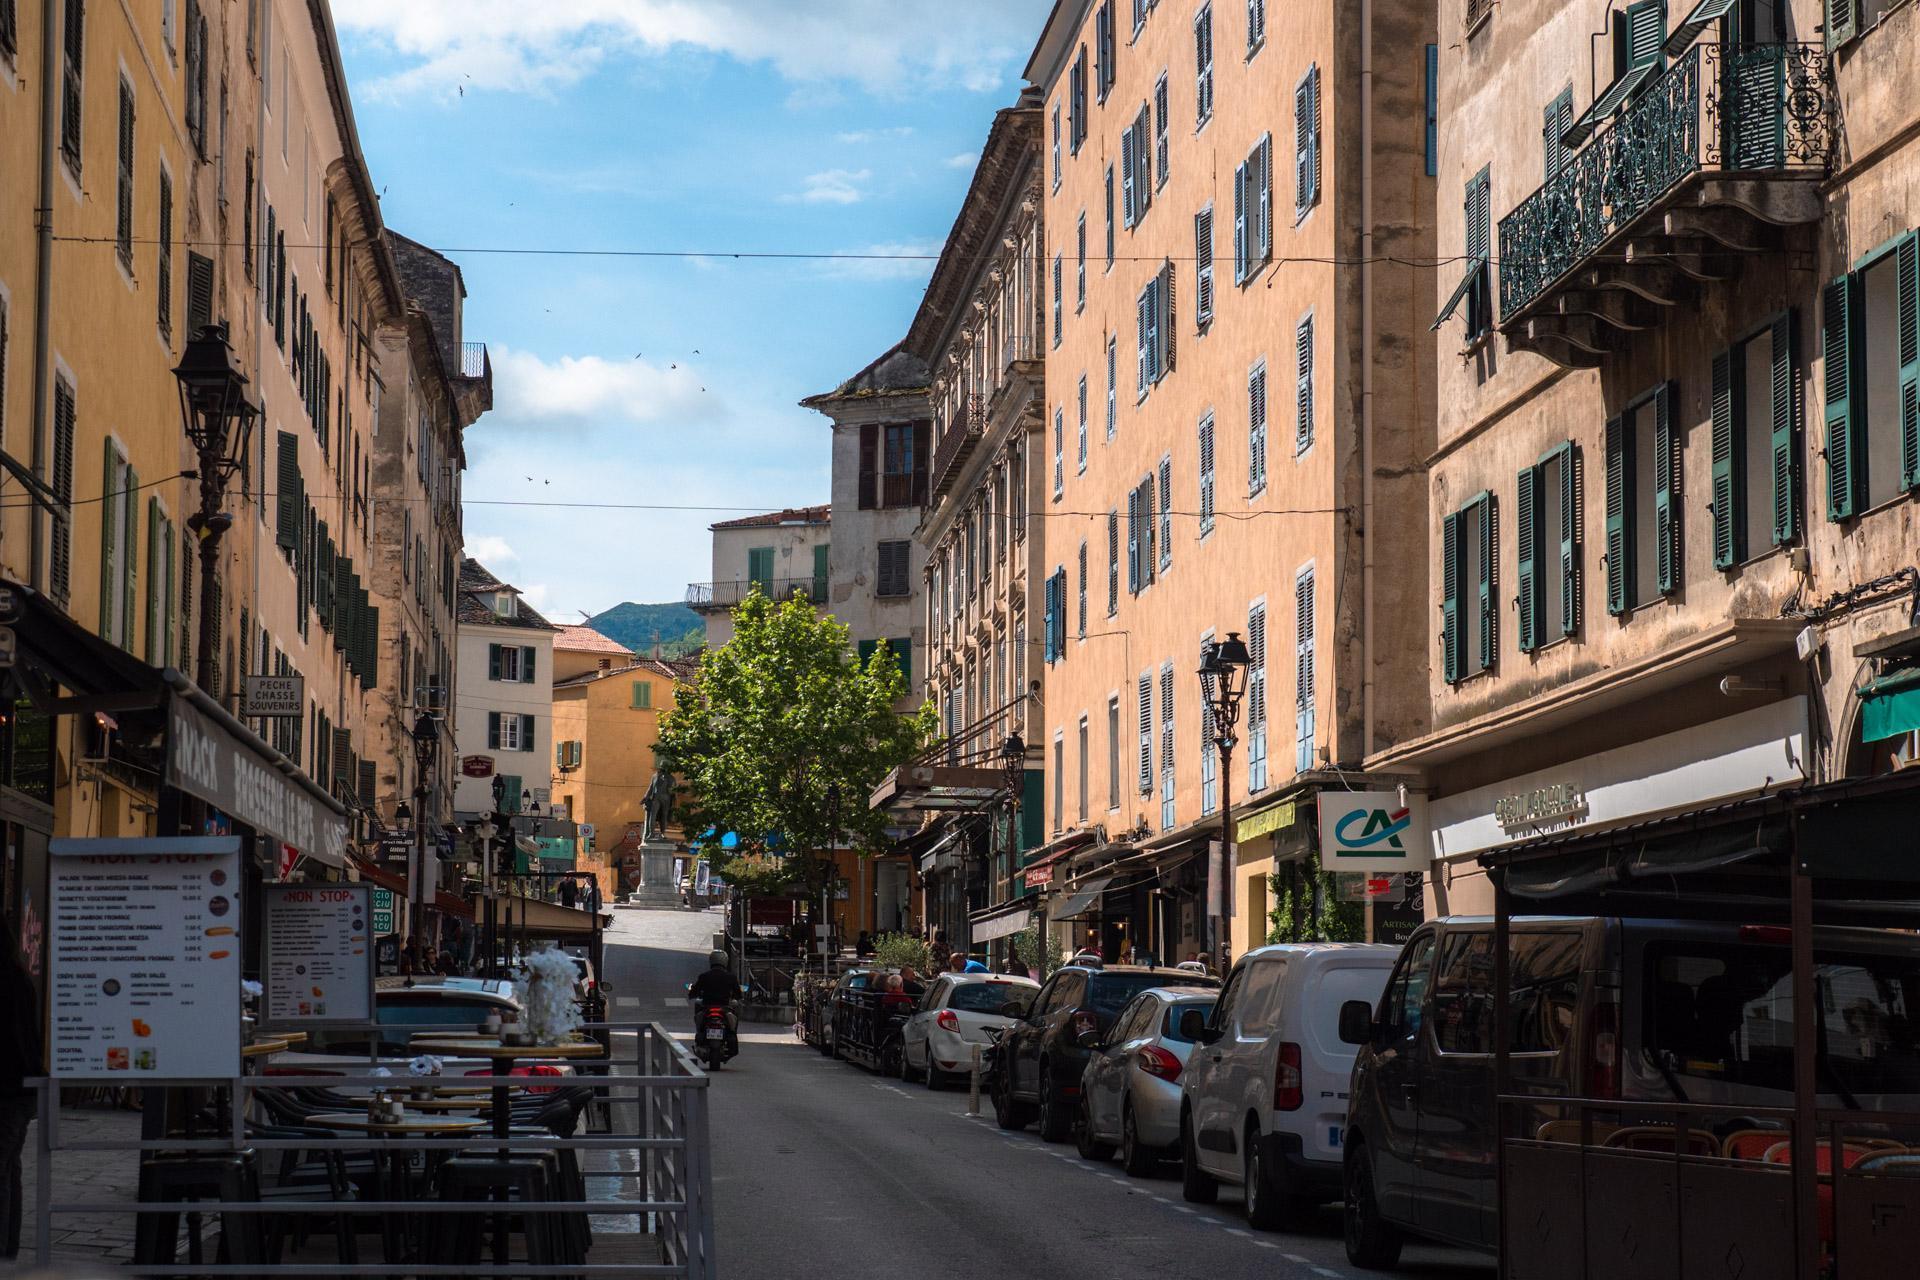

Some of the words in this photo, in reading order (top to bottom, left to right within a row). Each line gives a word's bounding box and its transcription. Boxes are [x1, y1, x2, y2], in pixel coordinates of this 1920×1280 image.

[259, 680, 292, 690] PECHE
[255, 691, 295, 701] CHASSE
[249, 701, 300, 711] SOUVENIRS
